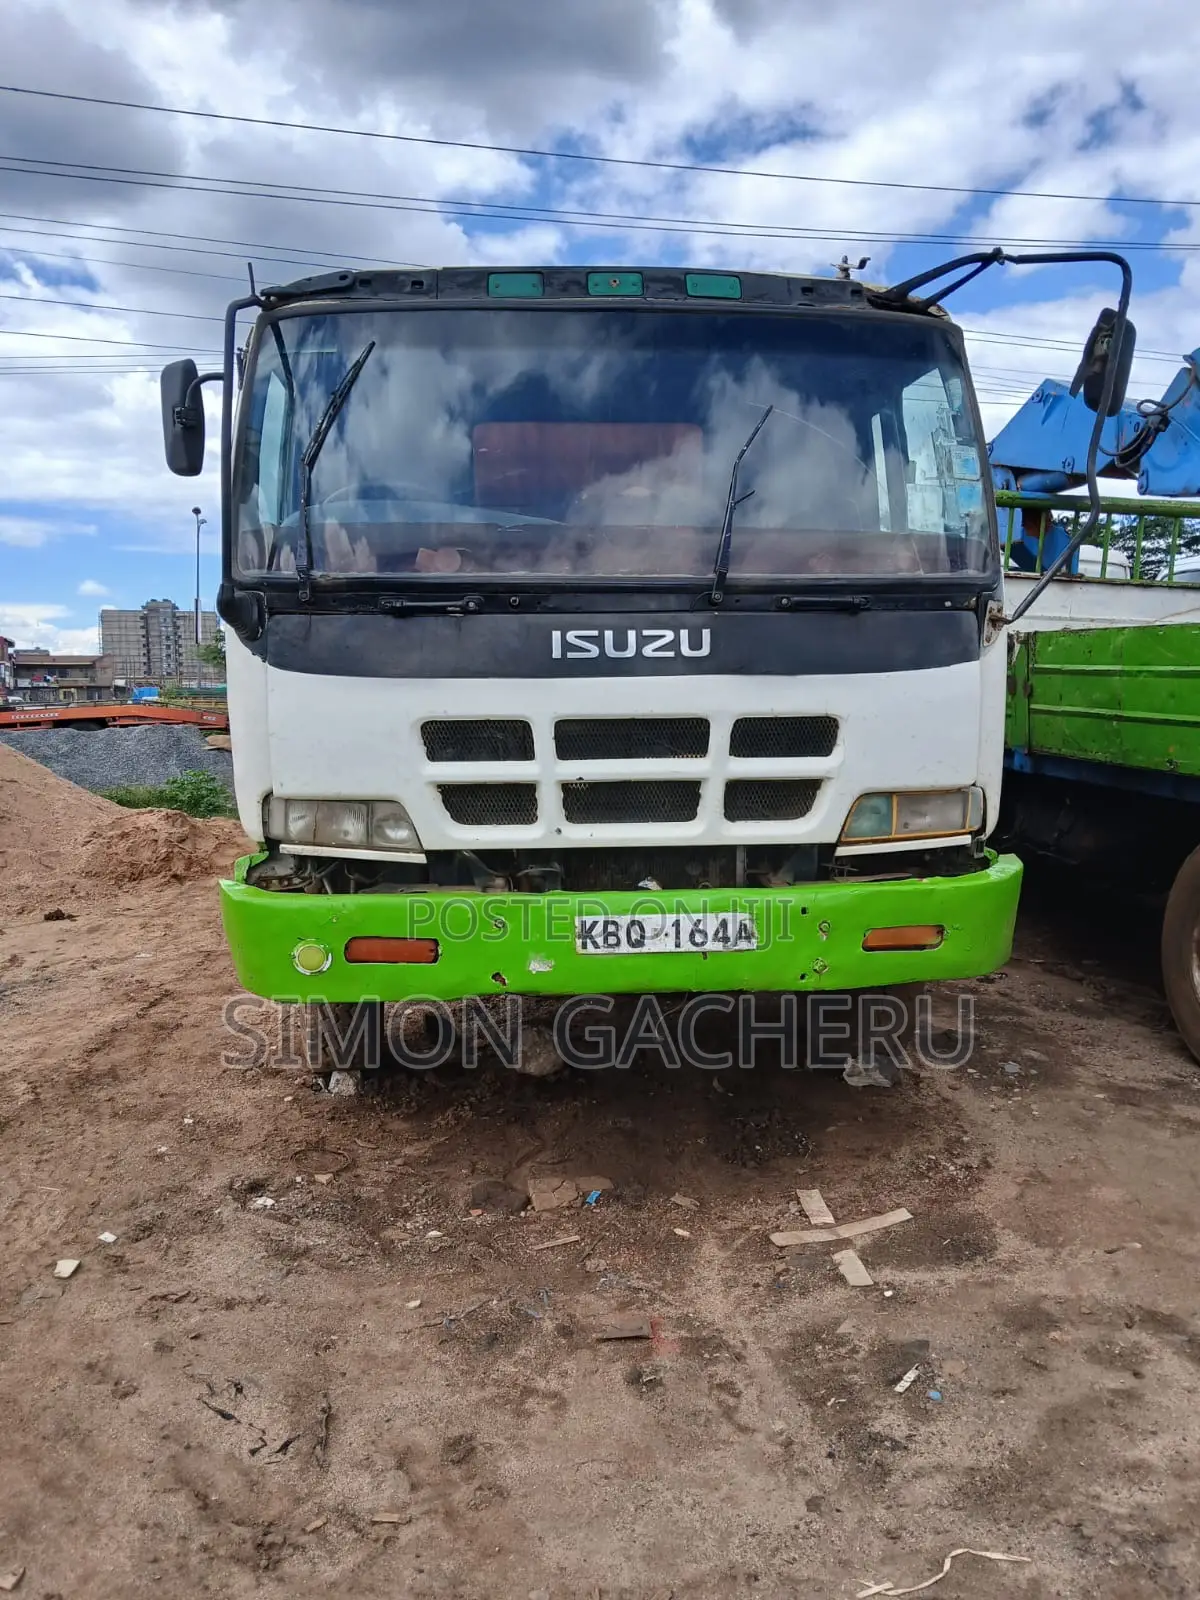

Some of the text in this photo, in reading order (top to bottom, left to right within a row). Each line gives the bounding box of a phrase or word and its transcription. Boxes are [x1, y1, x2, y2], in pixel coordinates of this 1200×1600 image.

[552, 628, 711, 659] ISUZU
[579, 917, 756, 950] KBQ 164A
